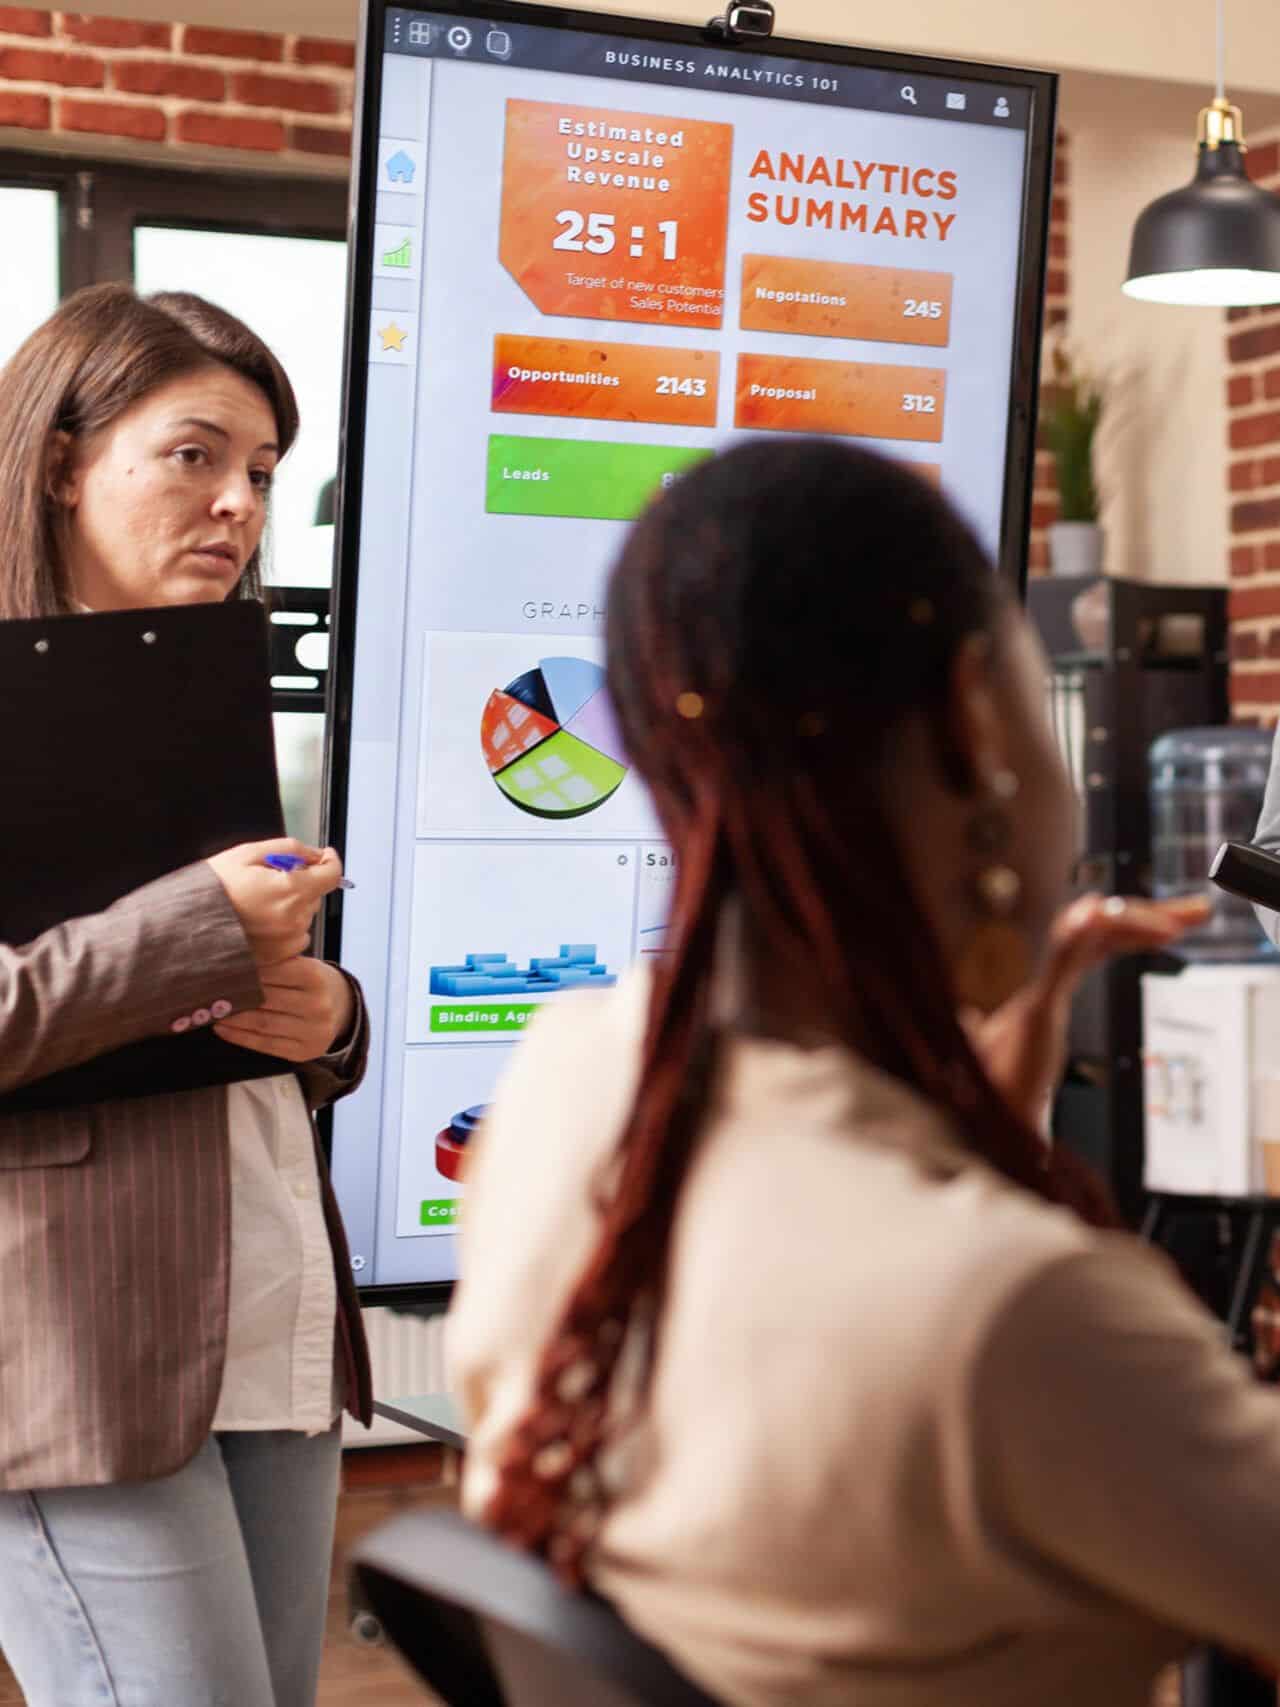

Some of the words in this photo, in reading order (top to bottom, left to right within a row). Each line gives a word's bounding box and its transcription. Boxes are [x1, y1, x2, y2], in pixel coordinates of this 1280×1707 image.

[605, 51, 696, 73] BUSINESS
[704, 63, 804, 87] ANALYTICS
[812, 77, 838, 91] 101
[558, 118, 684, 147] Estimated
[567, 142, 664, 168] Upscale
[567, 166, 671, 191] Revenue
[750, 149, 958, 200] ANALYTICS
[747, 192, 957, 241] SUMMARY
[553, 210, 616, 254] 25
[658, 220, 679, 260] 1
[565, 272, 606, 289] Target
[610, 277, 624, 289] of
[627, 281, 654, 292] new
[657, 282, 728, 298] customers
[629, 296, 662, 311] Sales
[903, 299, 943, 319] 245
[508, 366, 620, 387] Opportunities
[656, 376, 707, 396] 2143
[751, 384, 816, 400] Proposal
[902, 394, 937, 413] 312
[503, 467, 551, 481] Leads
[439, 1011, 499, 1024] Binding
